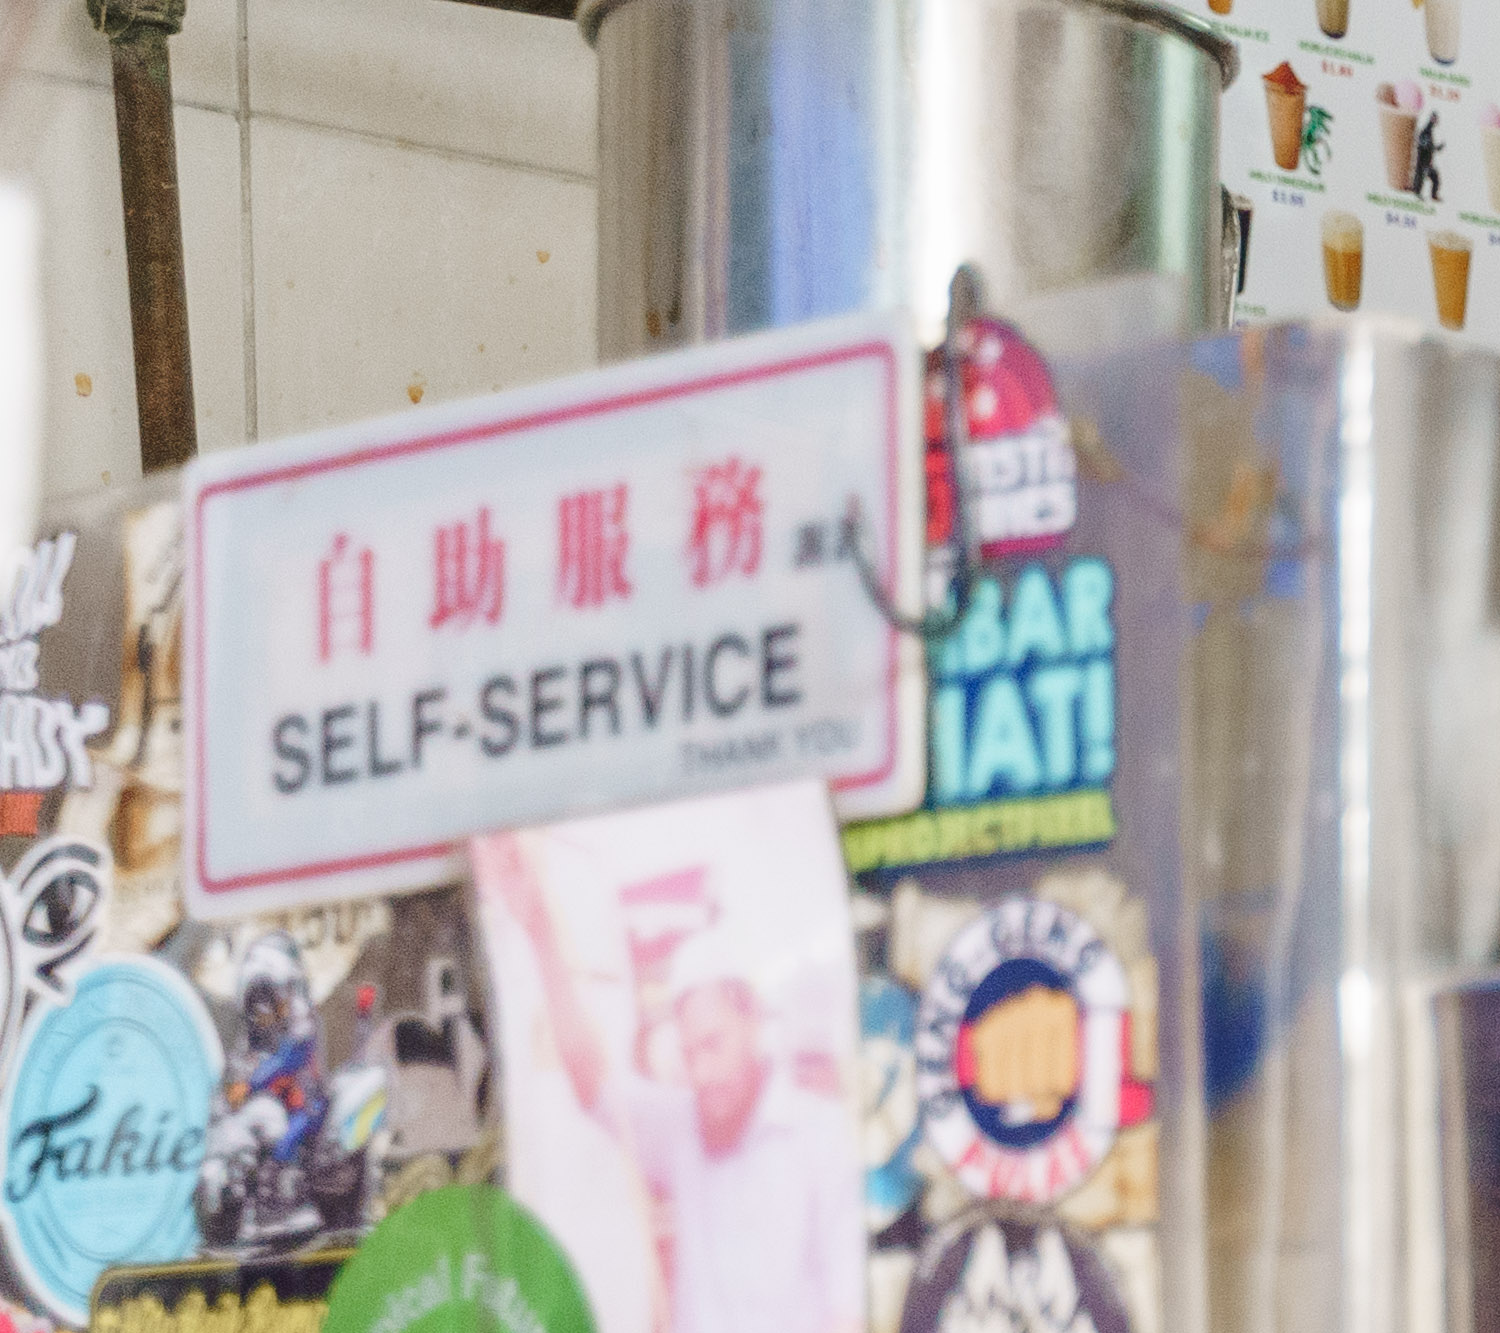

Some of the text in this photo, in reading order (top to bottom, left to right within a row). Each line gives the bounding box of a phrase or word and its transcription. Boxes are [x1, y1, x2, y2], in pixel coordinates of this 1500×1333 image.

[316, 455, 765, 667] 自助服務
[271, 621, 801, 796] SELF-SERVICE
